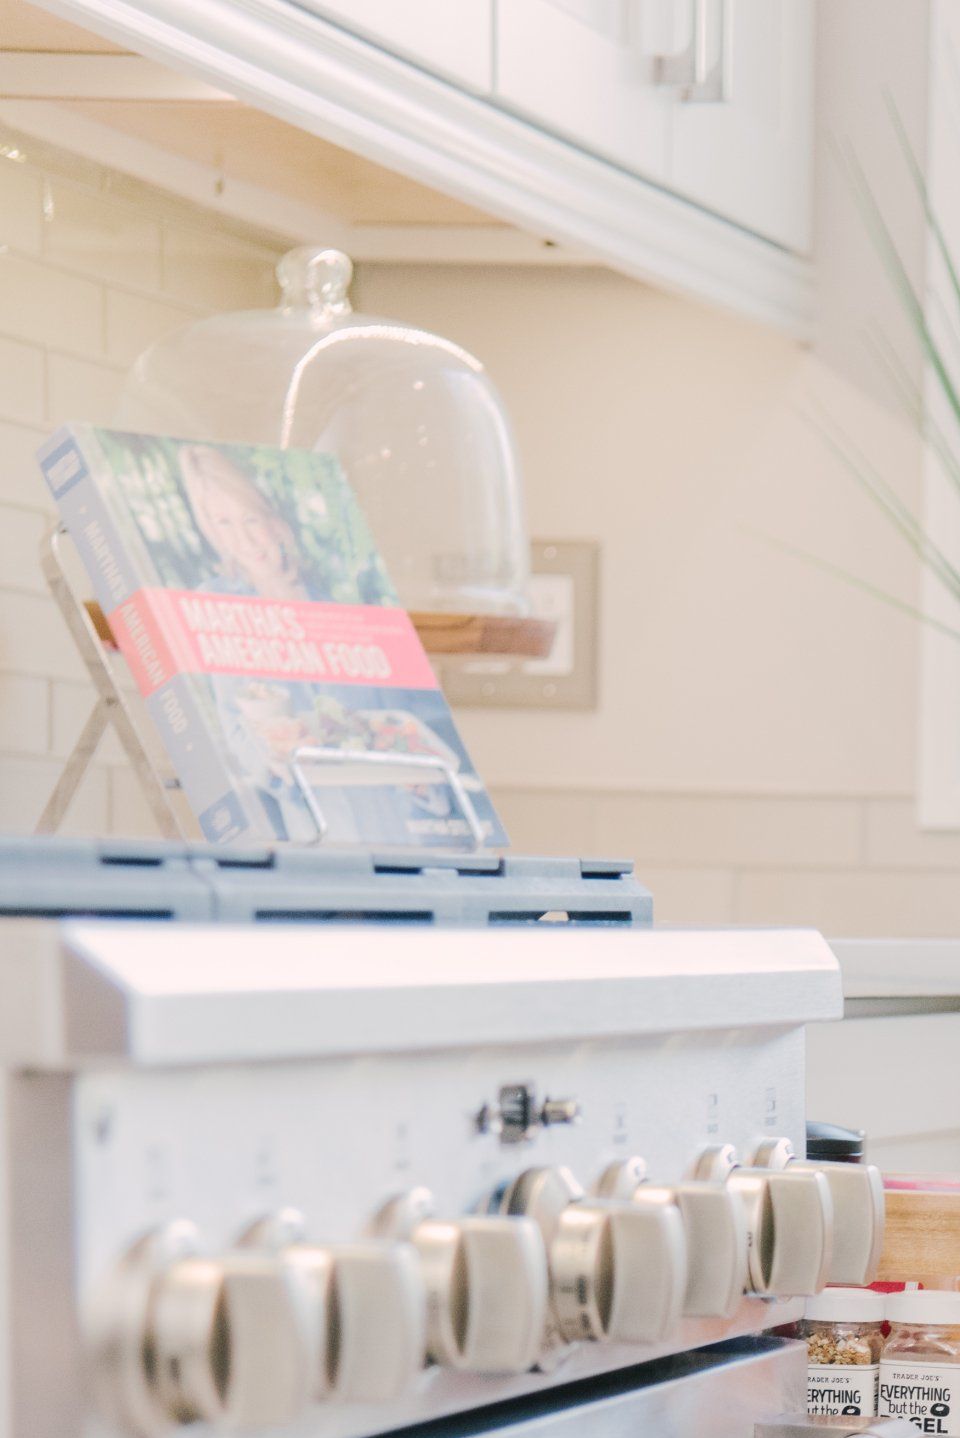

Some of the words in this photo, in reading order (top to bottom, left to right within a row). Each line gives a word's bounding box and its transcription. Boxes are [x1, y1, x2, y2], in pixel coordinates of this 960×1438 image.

[178, 597, 306, 640] MARTHA'S
[196, 632, 326, 674] AMERICAN
[323, 642, 392, 680] FOOD
[807, 1388, 861, 1404] ERYTHING
[880, 1384, 951, 1402] EVERYTHING
[807, 1404, 819, 1415] ut
[820, 1404, 839, 1416] the
[889, 1401, 908, 1414] but
[909, 1402, 928, 1416] the
